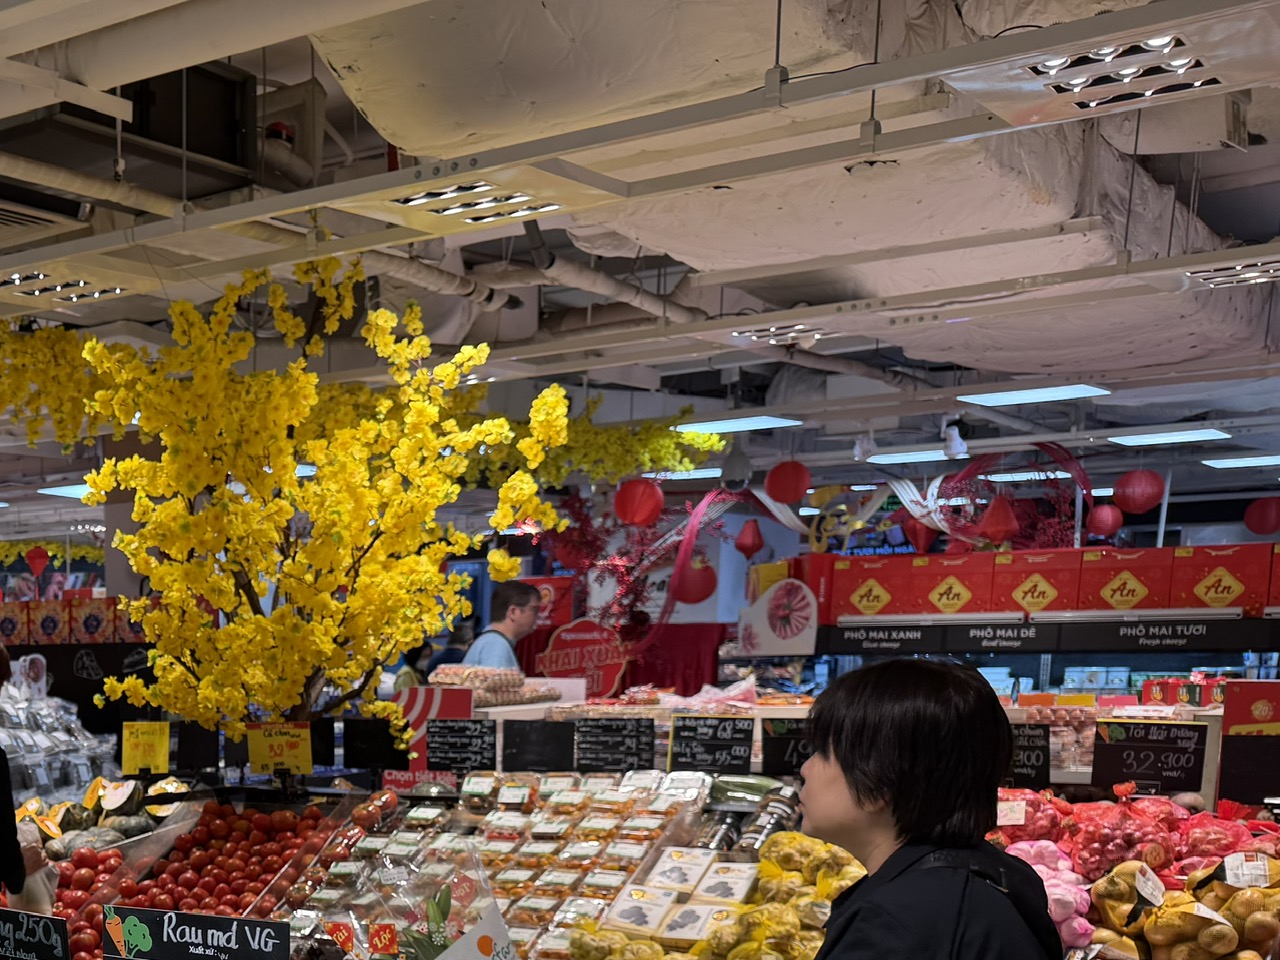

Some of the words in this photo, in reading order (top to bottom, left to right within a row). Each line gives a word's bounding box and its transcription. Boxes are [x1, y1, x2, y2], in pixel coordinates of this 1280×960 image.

[870, 630, 889, 640] MAI
[890, 630, 921, 640] XANH
[996, 629, 1017, 638] MAI
[1120, 624, 1145, 637] PHÔ
[1149, 625, 1171, 636] MAI
[162, 912, 203, 944] Rau
